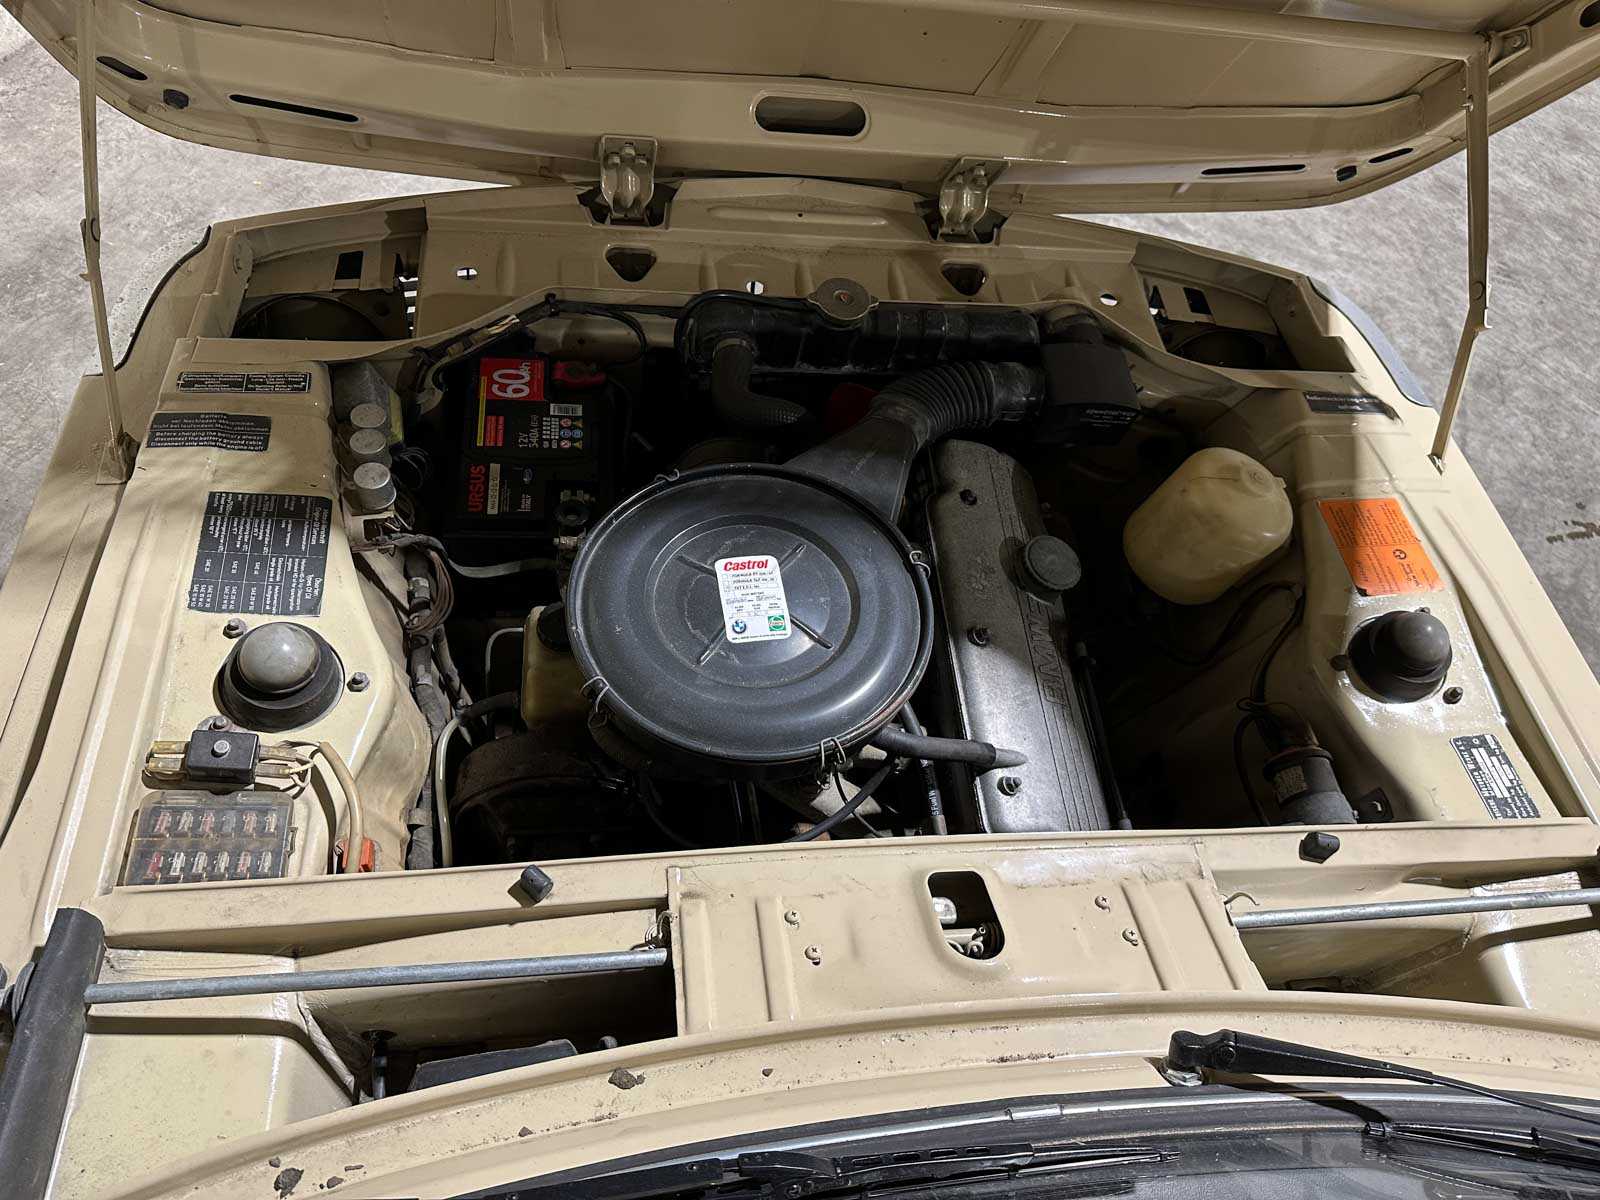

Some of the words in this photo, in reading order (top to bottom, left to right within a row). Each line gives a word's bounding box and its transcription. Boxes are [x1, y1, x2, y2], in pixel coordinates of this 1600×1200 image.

[492, 369, 530, 398] 60
[518, 432, 528, 448] 12V
[468, 464, 485, 512] URSUS
[724, 559, 768, 572] Castrol
[1027, 616, 1067, 707] BMW
[929, 797, 938, 810] Fuel
